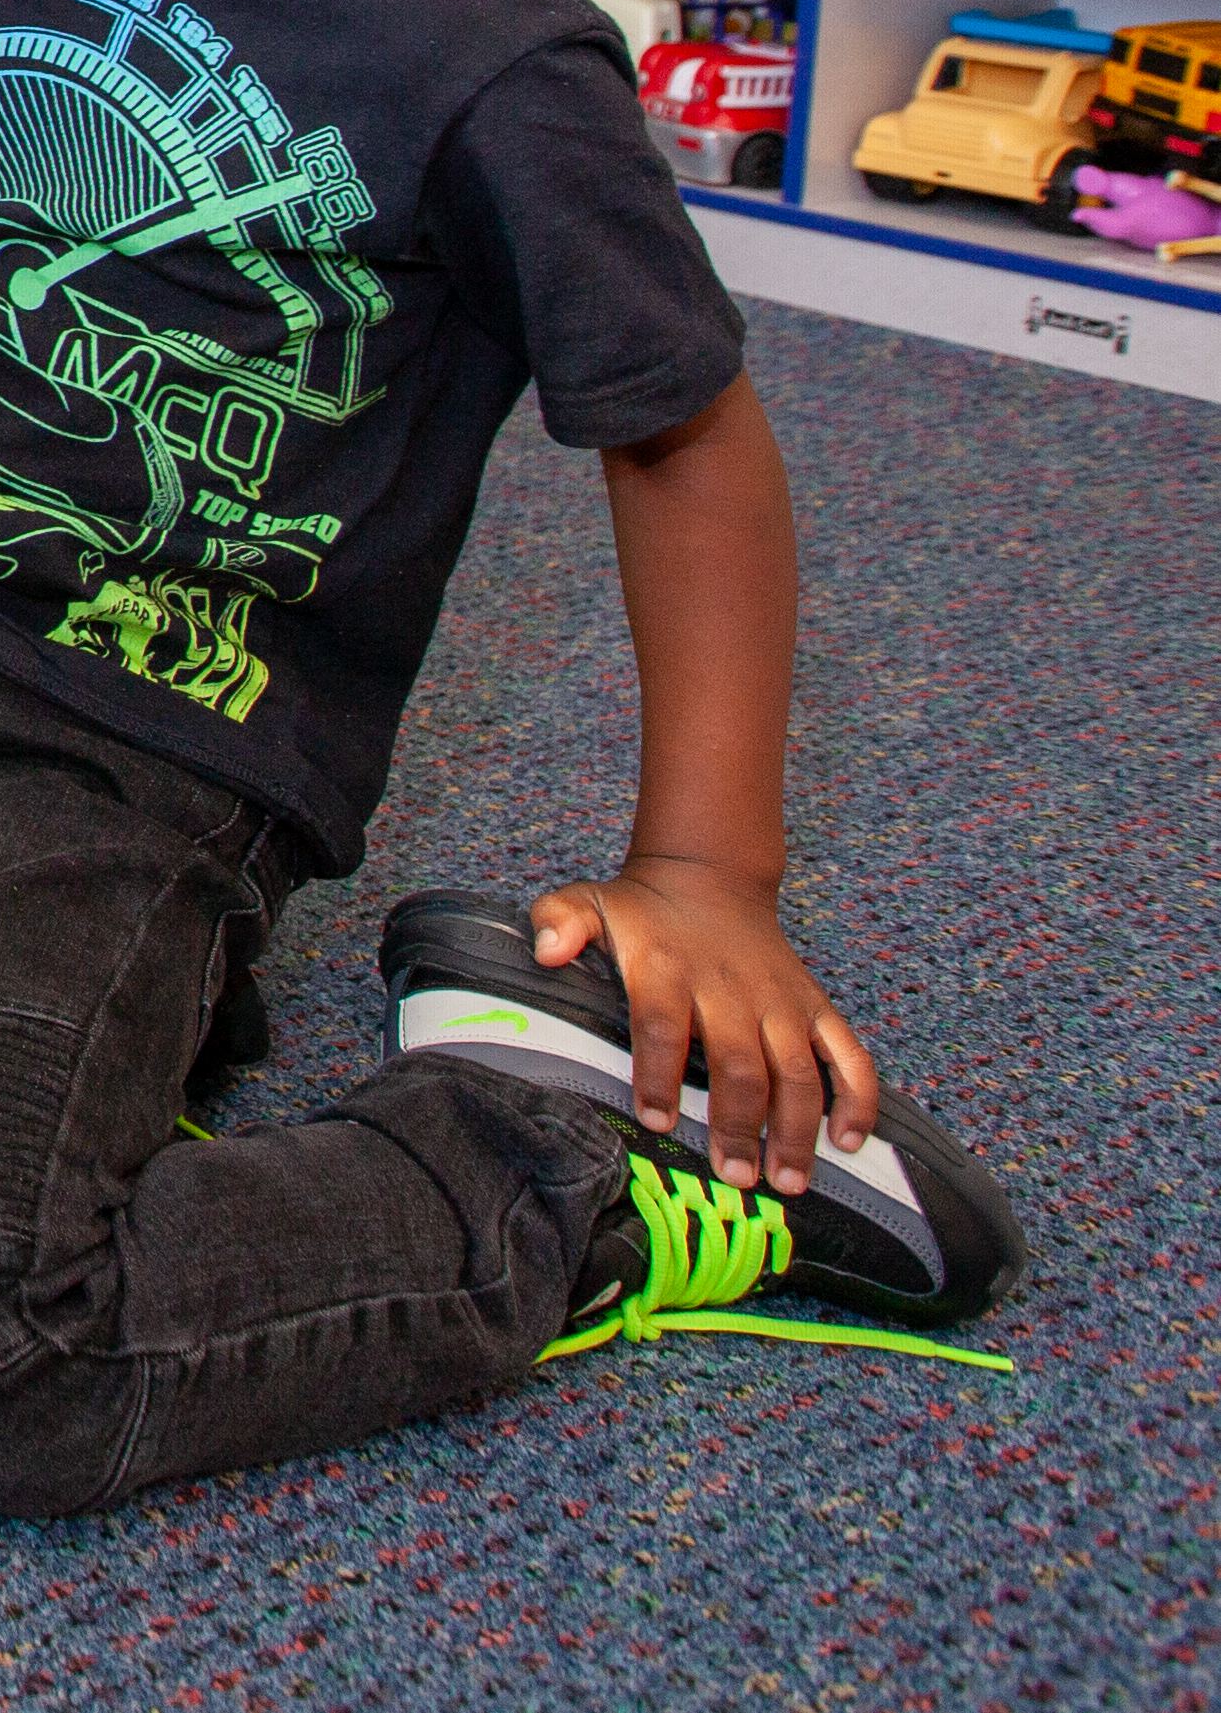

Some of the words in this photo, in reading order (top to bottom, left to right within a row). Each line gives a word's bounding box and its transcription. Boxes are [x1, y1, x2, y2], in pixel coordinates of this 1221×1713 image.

[169, 6, 229, 68] 184
[230, 68, 288, 145] 185
[290, 129, 373, 225] 186
[245, 356, 295, 383] SPEED
[190, 488, 249, 528] TOP
[247, 512, 342, 544] SPEED
